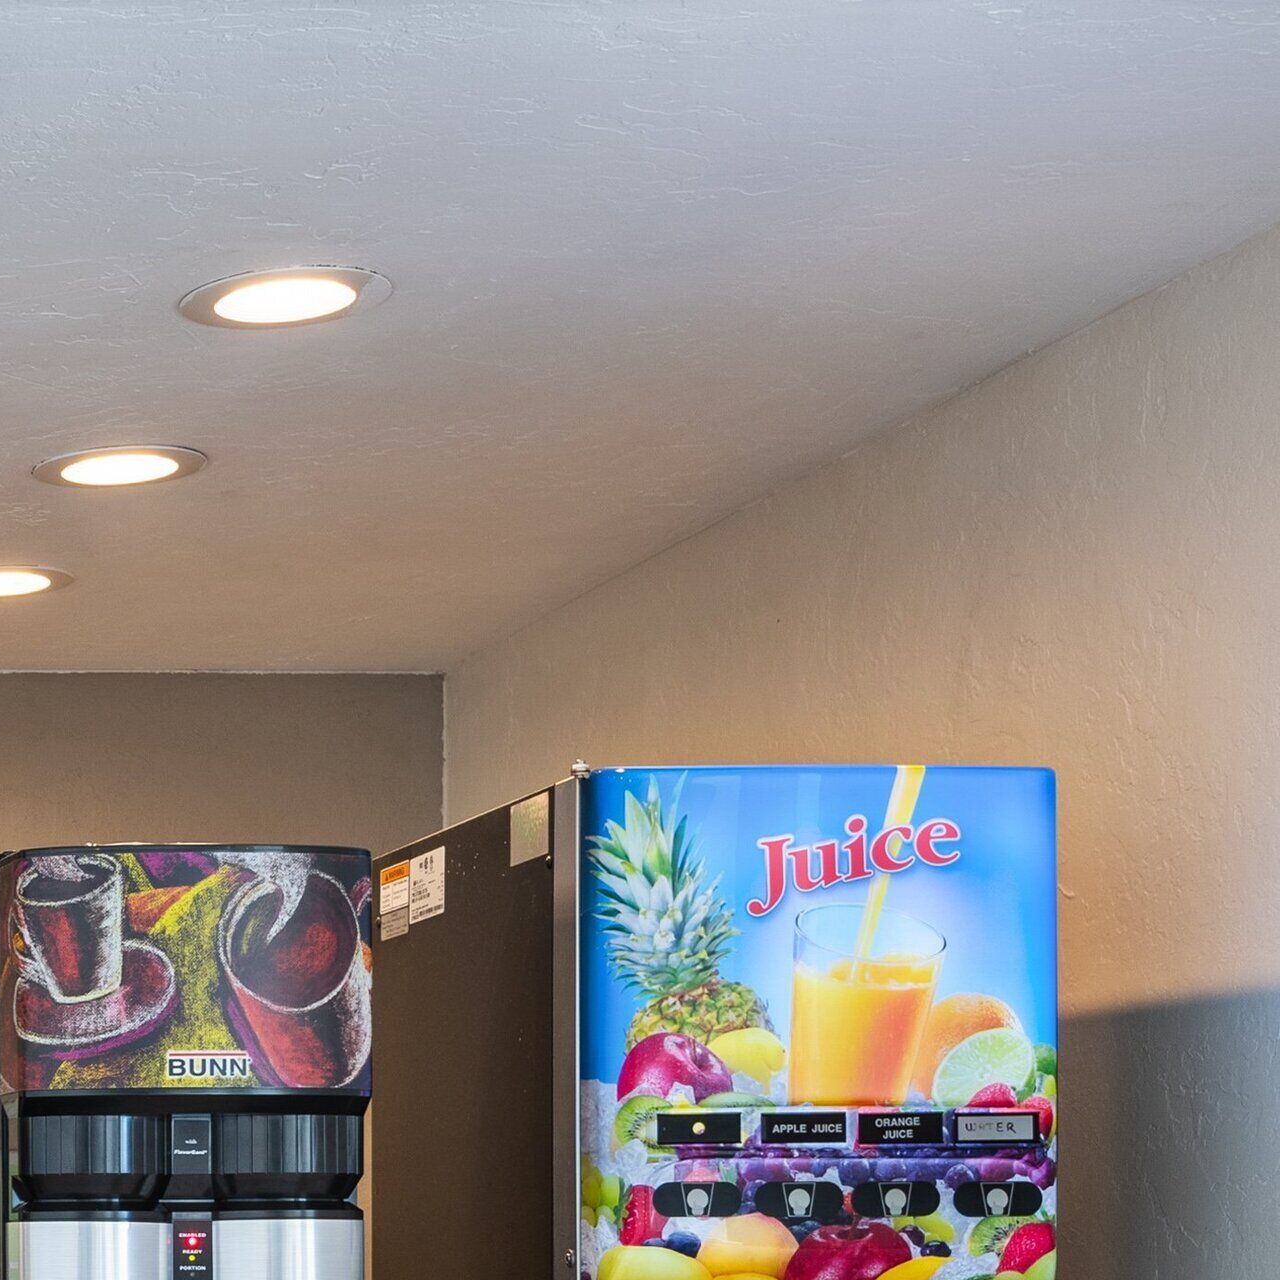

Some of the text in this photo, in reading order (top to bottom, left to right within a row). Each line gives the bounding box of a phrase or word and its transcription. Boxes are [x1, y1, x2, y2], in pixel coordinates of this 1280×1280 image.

[747, 815, 960, 917] Juice
[168, 1058, 247, 1076] BUNN
[874, 1116, 921, 1128] ORANGE
[772, 1123, 843, 1134] APPLE JUICE
[882, 1129, 914, 1140] JUICE
